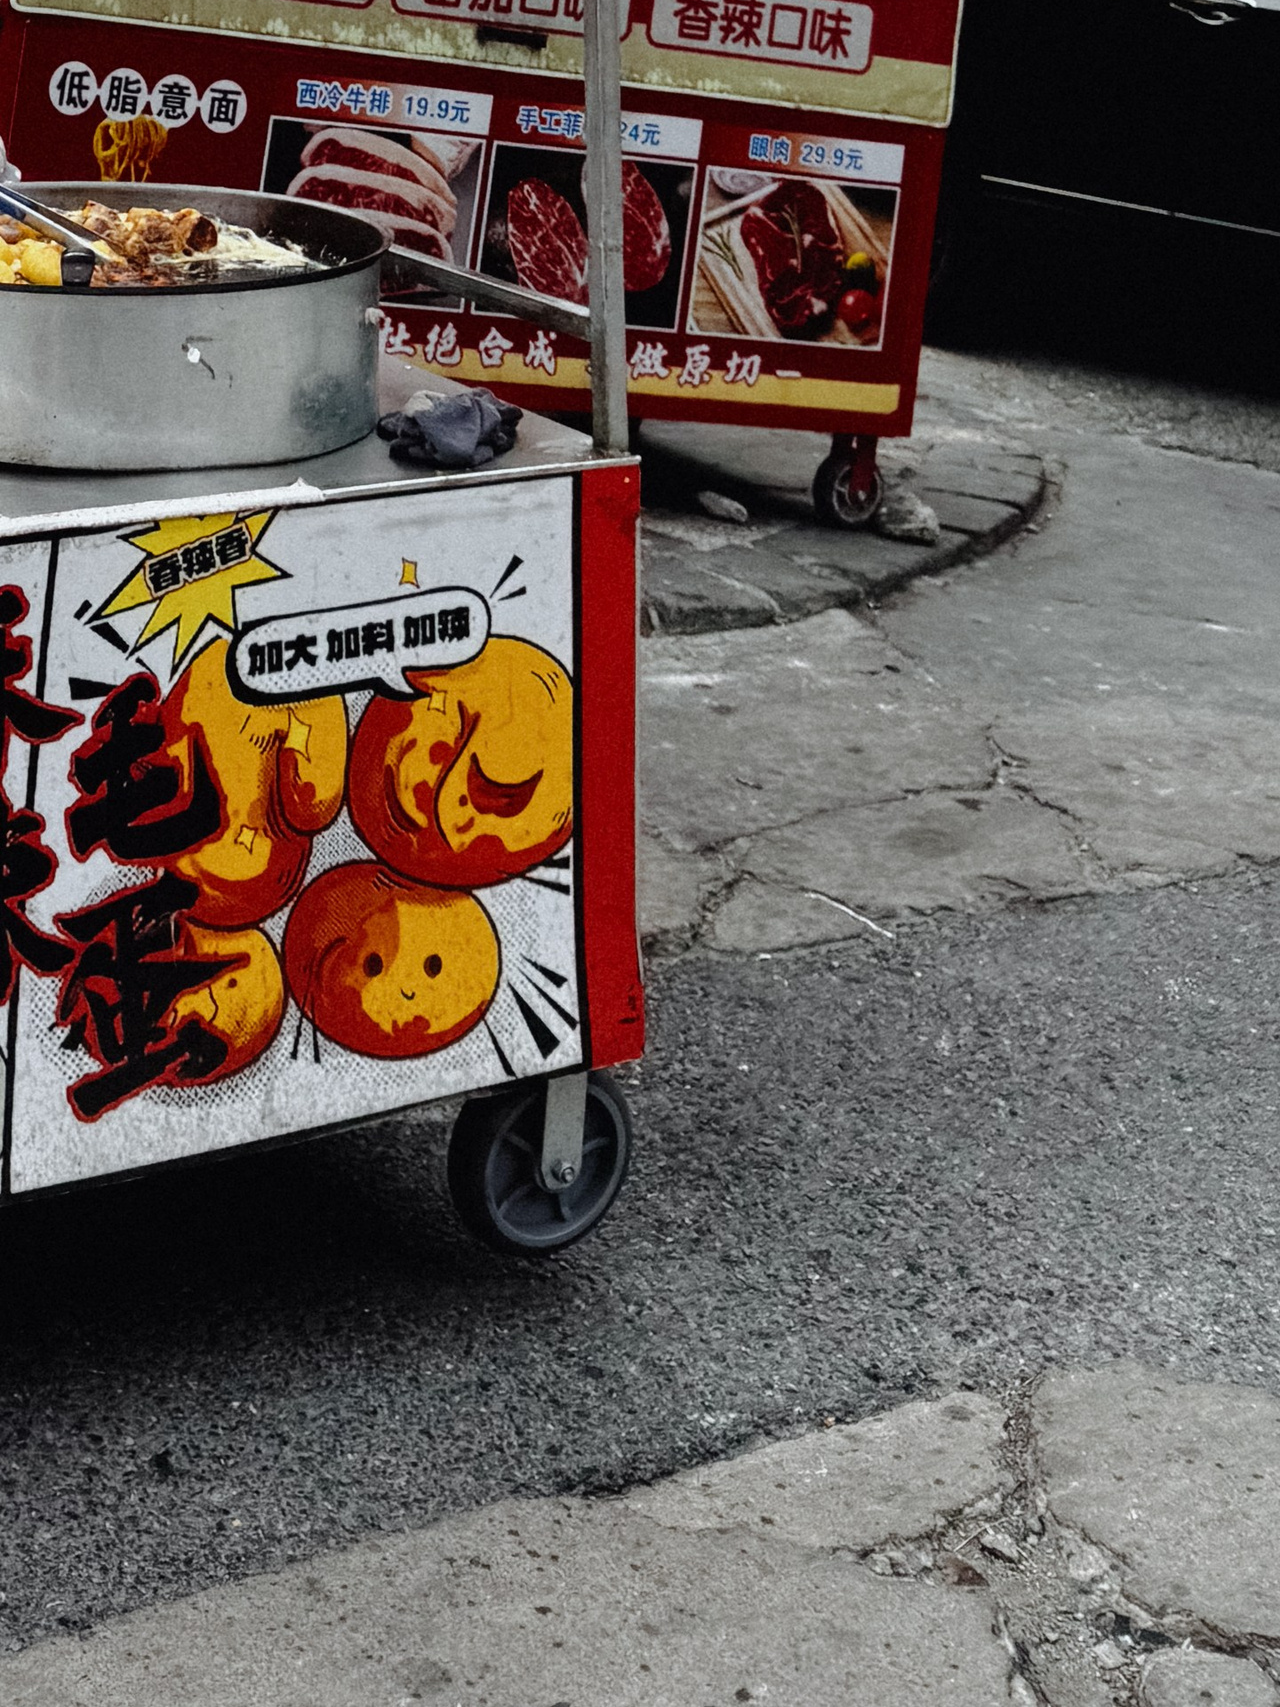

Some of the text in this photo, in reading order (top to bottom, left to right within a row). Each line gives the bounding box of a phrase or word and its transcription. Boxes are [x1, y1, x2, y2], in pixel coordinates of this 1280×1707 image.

[56, 67, 242, 127] 低脂意面
[297, 79, 472, 125] 西冷牛排 19.9元
[517, 106, 587, 139] 手工菲
[749, 135, 865, 171] 眼肉 29.9元
[379, 317, 557, 376] 杜绝合成
[147, 524, 250, 594] 香辣香
[248, 606, 470, 677] 加大 加料 加辣
[53, 672, 251, 1122] 毛蛋
